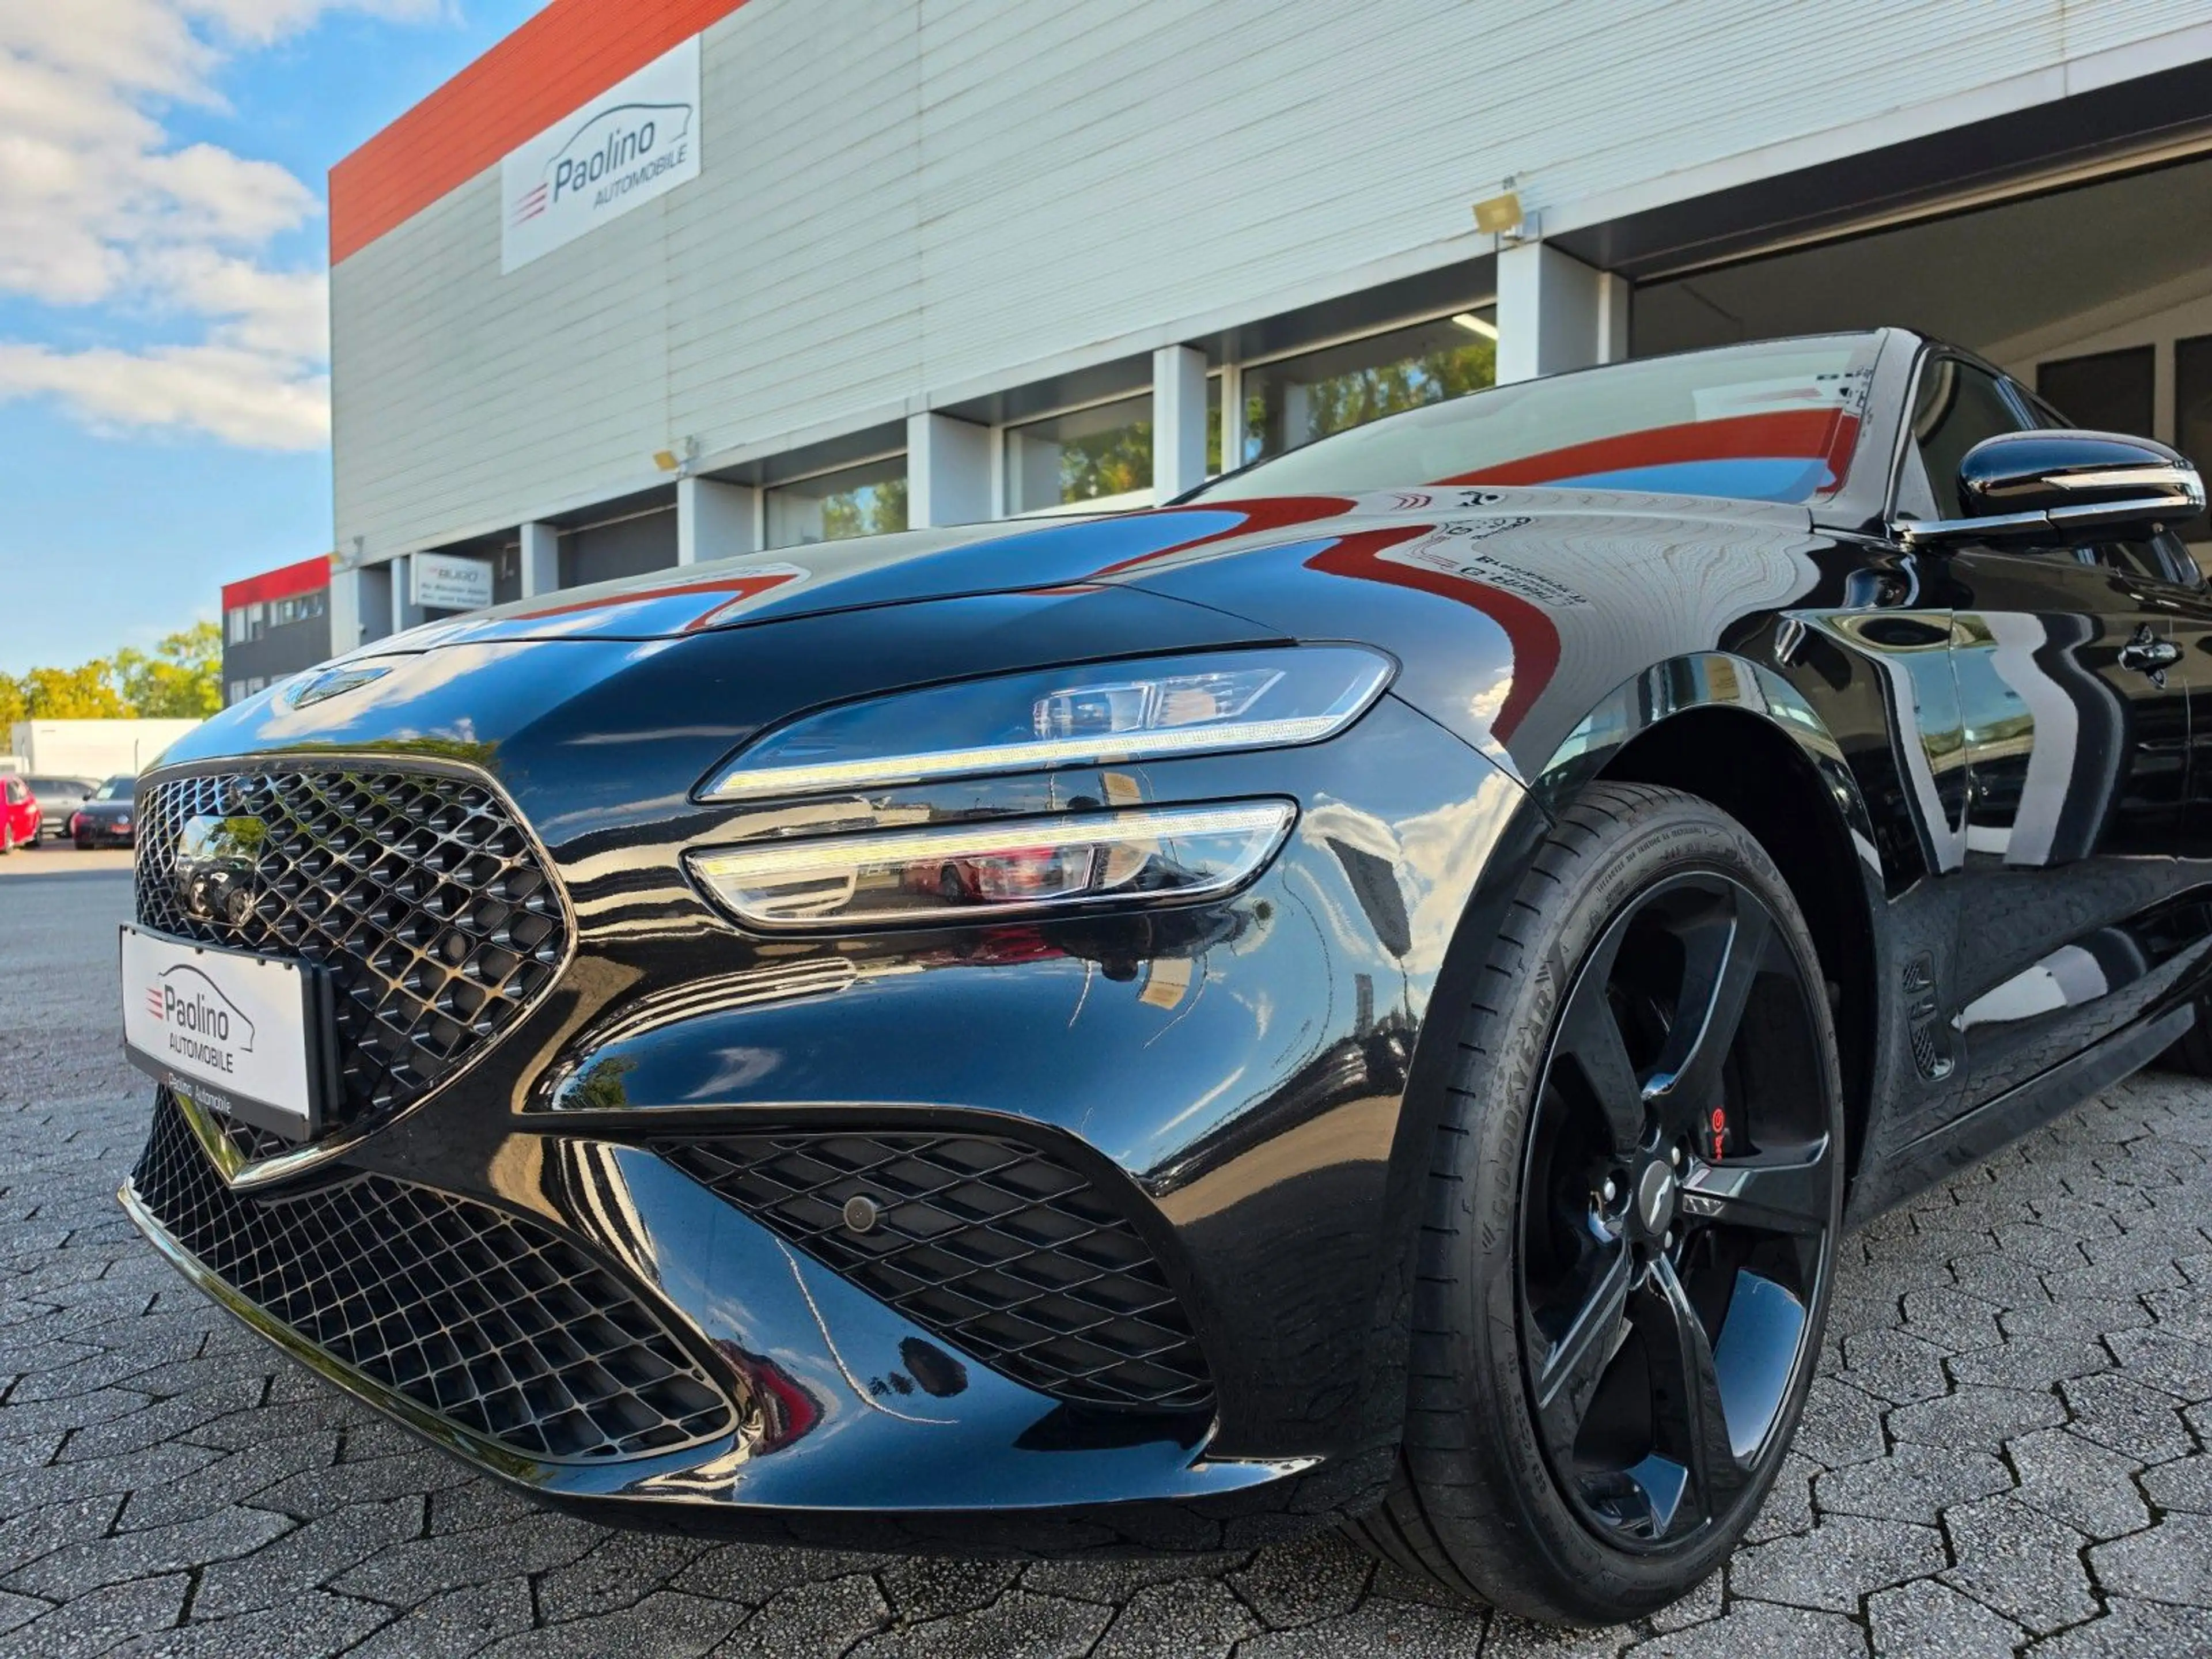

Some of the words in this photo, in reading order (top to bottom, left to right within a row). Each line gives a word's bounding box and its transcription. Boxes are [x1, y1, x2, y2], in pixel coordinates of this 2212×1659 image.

[554, 122, 655, 203] Paolino
[593, 143, 688, 210] AUTOMOBILE
[165, 984, 229, 1040] Paolino
[169, 1032, 233, 1073] AUTOMOBILE
